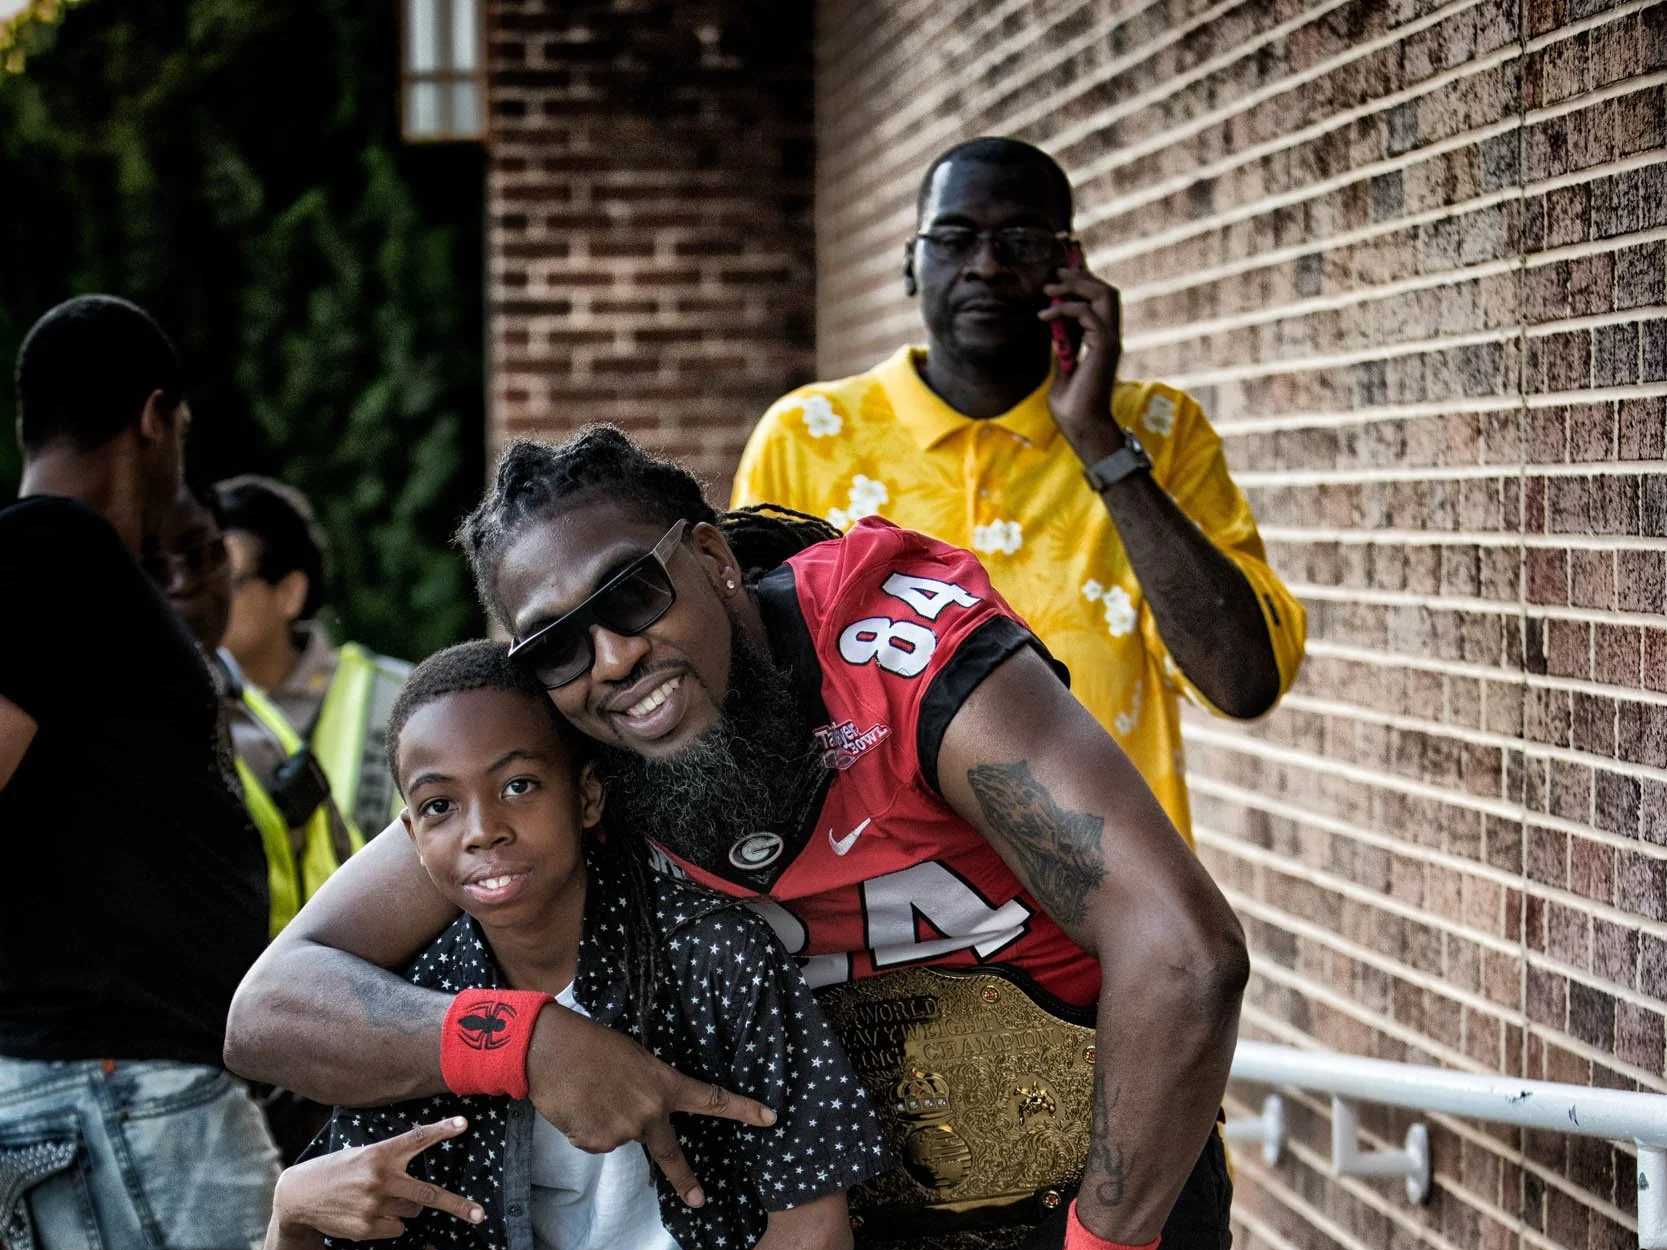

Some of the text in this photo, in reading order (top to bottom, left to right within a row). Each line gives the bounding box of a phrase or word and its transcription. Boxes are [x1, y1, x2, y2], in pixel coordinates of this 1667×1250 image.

[838, 573, 983, 678] 84
[859, 998, 938, 1024] WORLD
[922, 1028, 1055, 1062] CHAMPION
